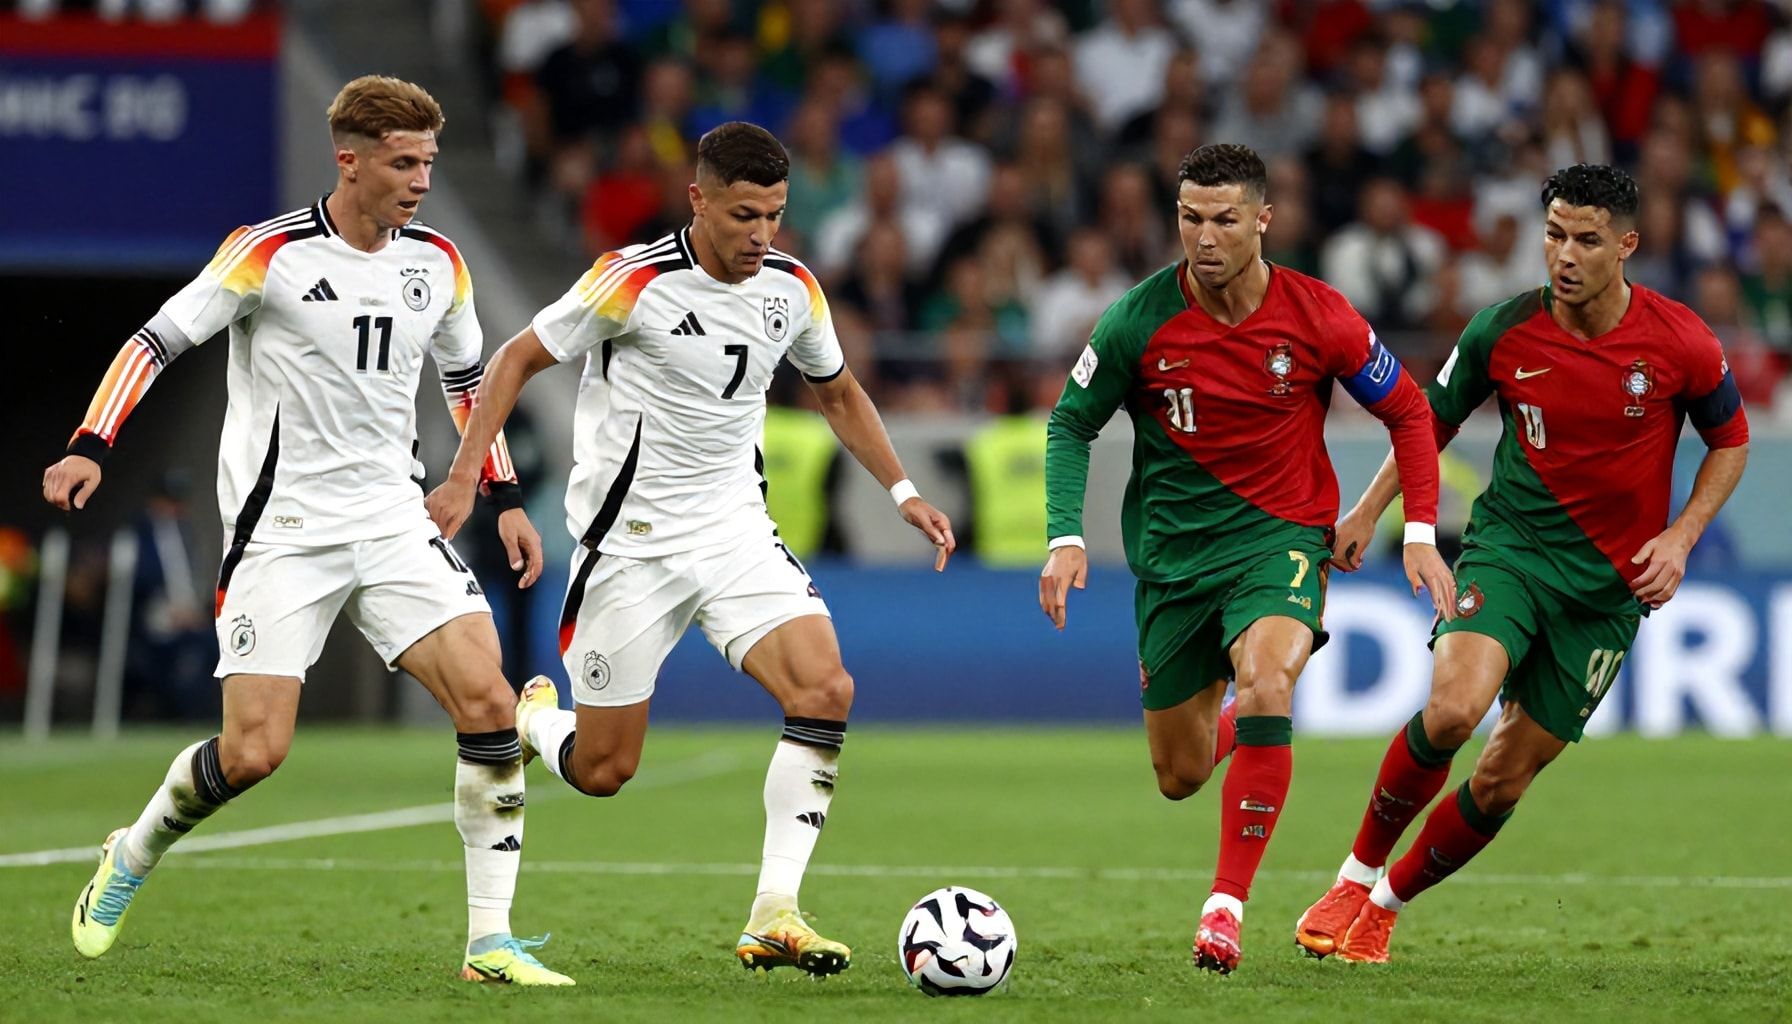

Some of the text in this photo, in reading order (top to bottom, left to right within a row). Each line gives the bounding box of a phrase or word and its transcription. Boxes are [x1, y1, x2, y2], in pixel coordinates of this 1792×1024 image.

[352, 315, 394, 374] 11
[720, 344, 749, 400] 7
[1288, 549, 1310, 588] 7
